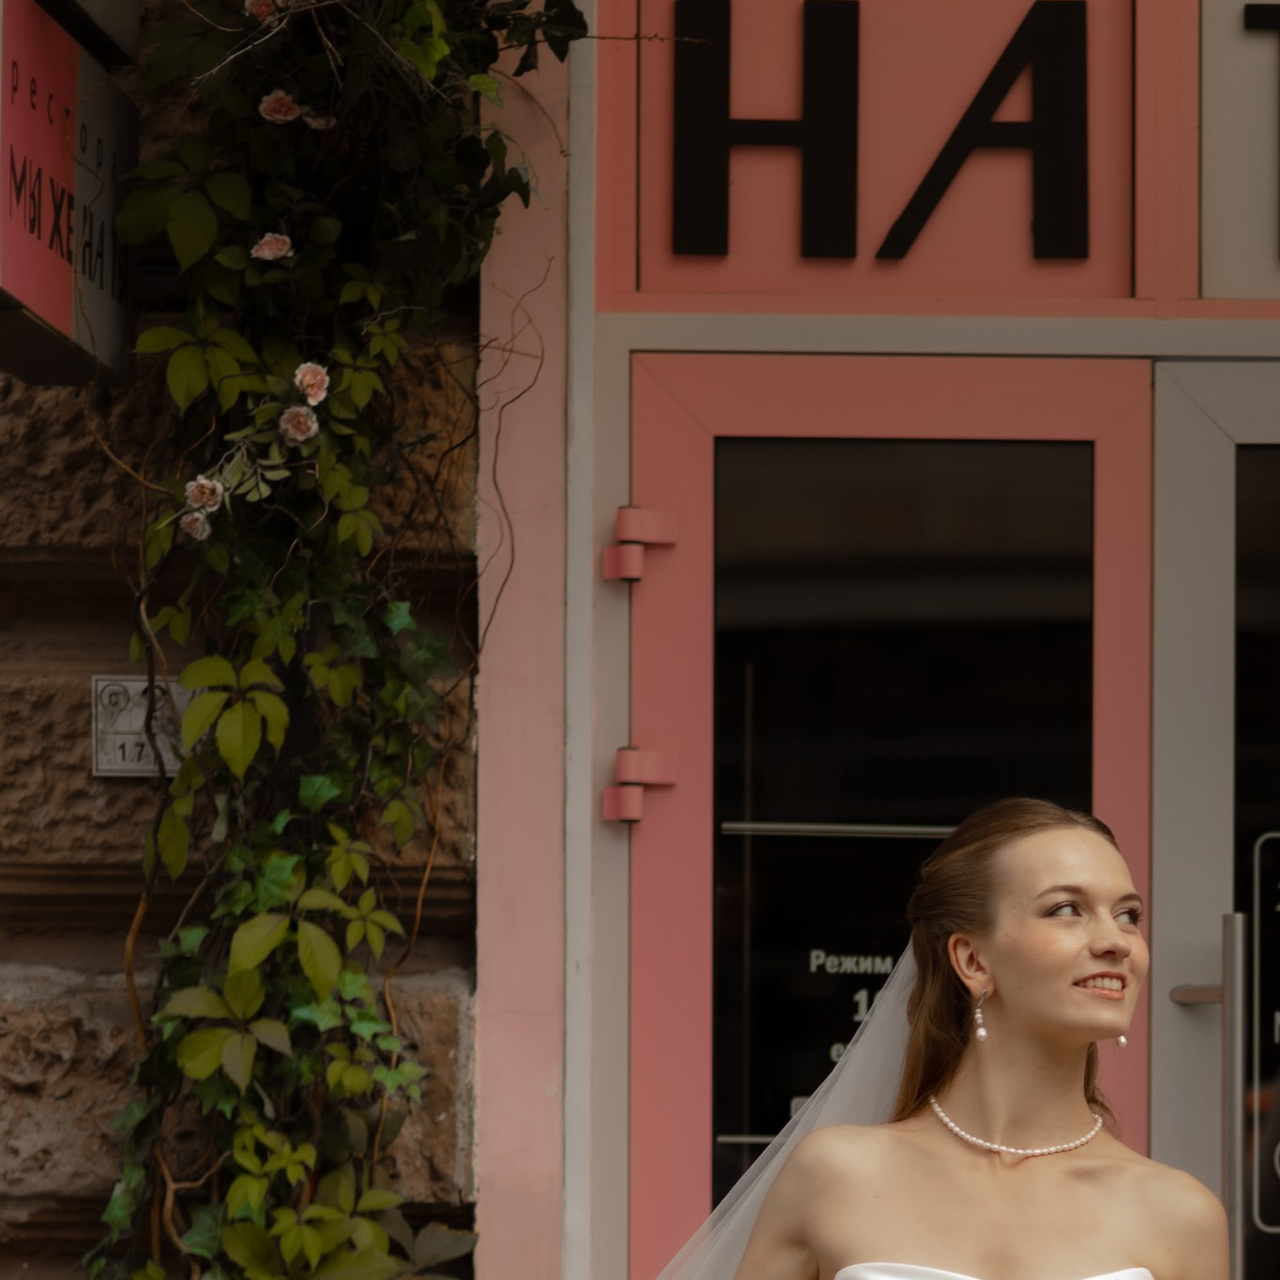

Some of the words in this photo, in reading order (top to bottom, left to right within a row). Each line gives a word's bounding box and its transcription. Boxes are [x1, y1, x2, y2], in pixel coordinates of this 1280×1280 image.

[672, 0, 1091, 260] НА
[49, 176, 75, 267] ЖЕ
[82, 204, 105, 291] НА
[809, 949, 893, 975] Режим
